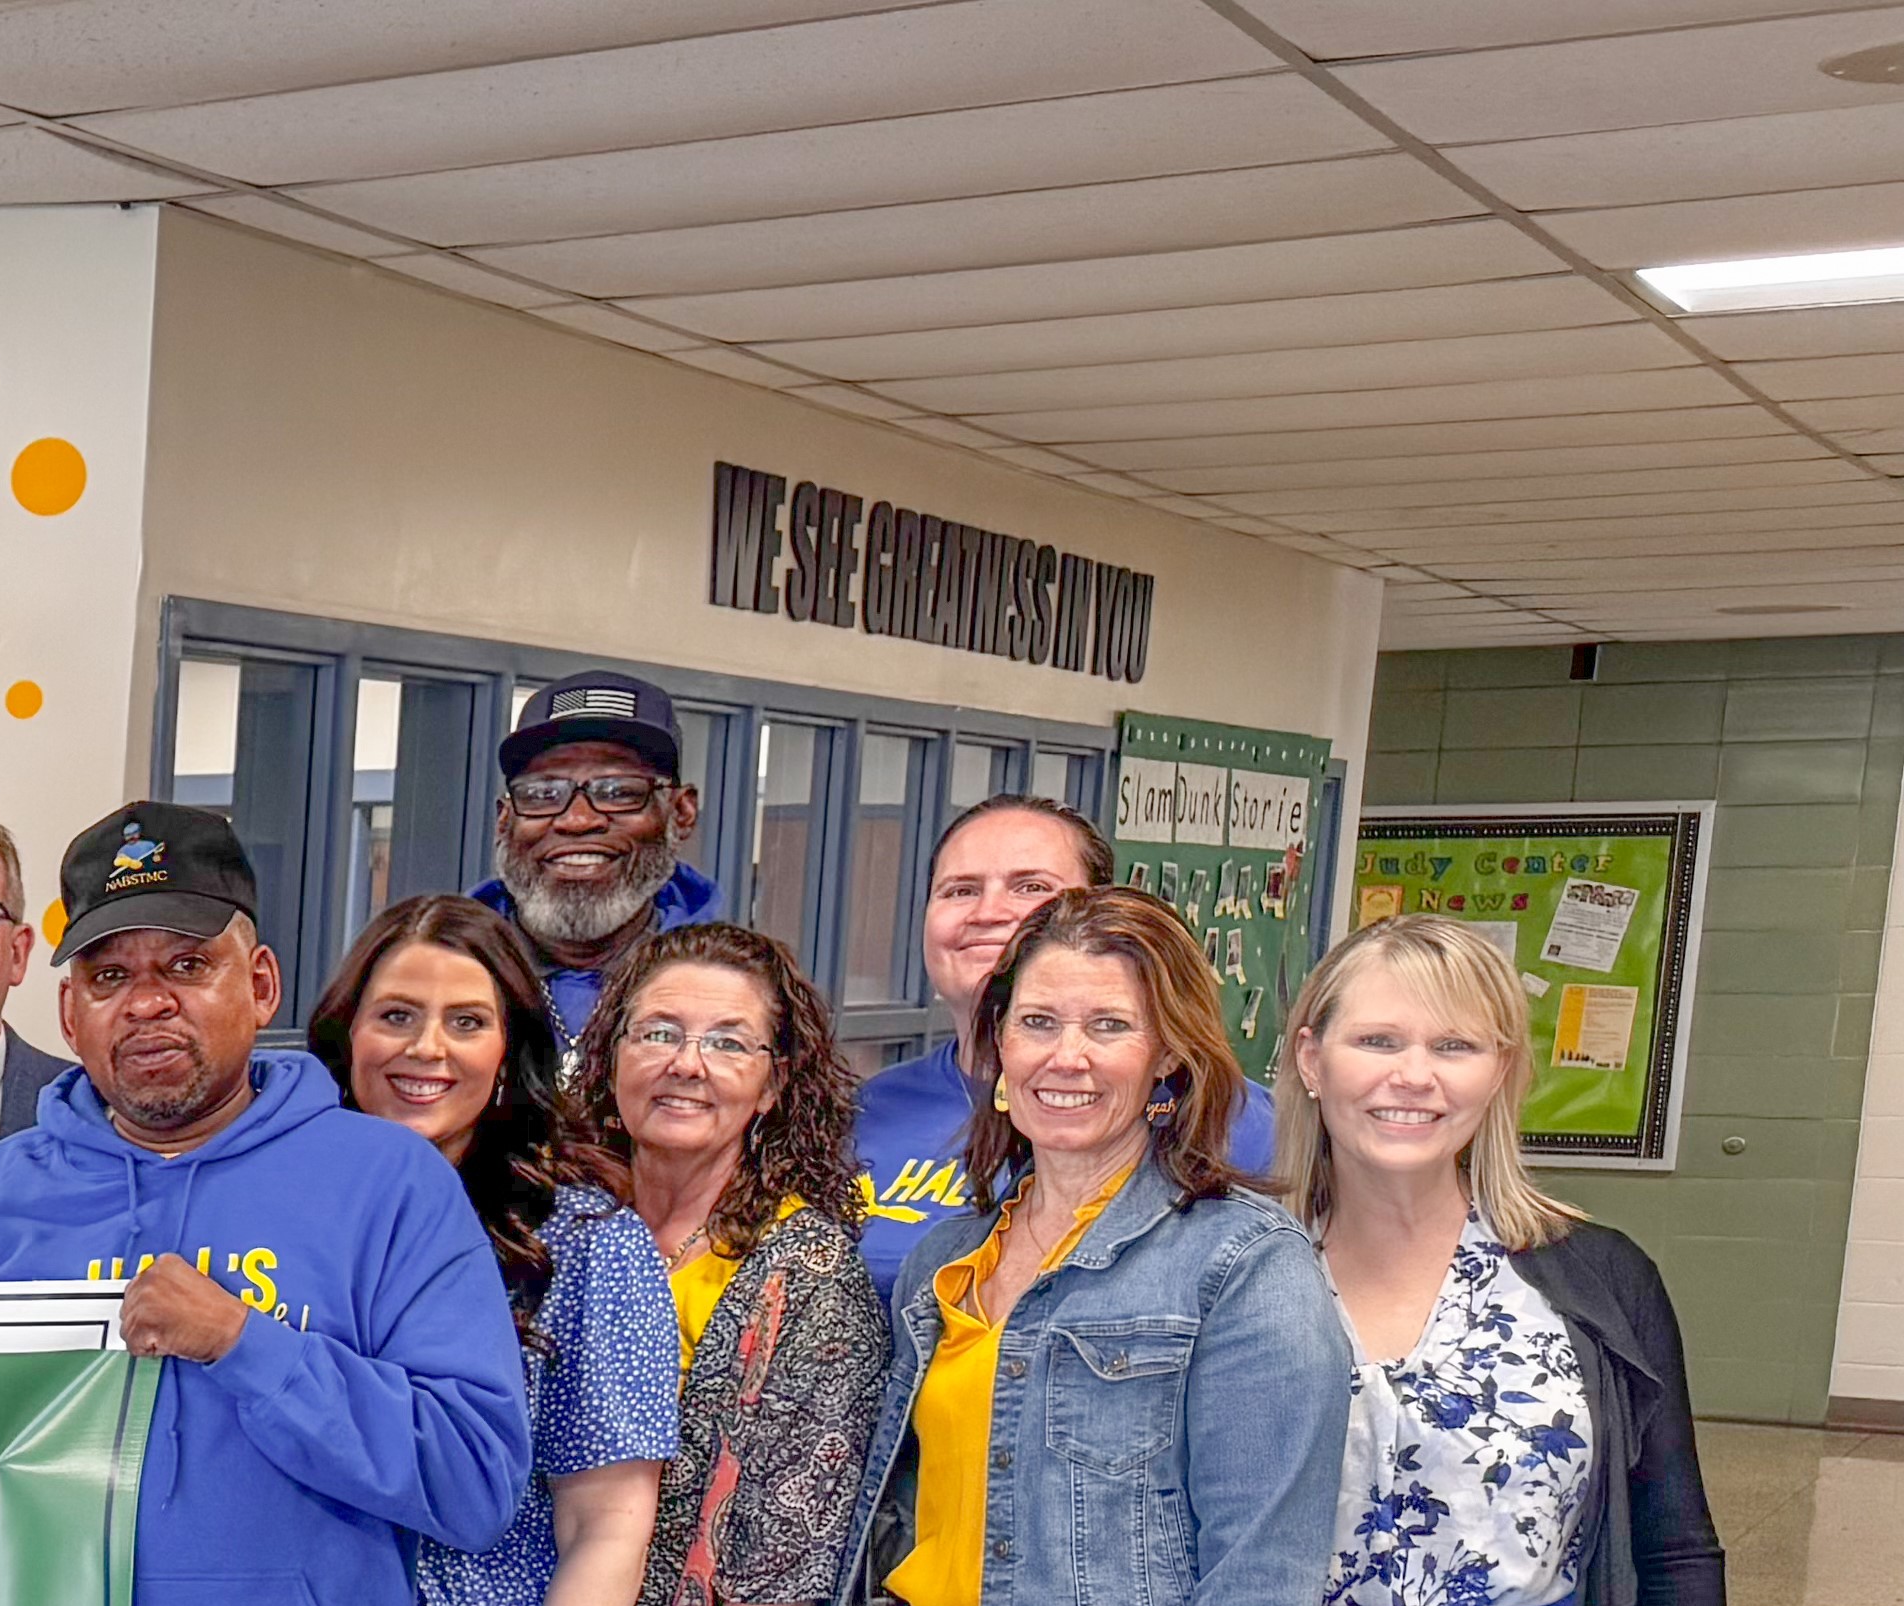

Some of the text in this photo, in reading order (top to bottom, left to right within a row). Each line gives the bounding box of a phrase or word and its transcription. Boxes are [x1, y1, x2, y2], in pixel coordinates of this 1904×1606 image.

[709, 460, 1155, 684] WE SEE GREATNESS IN YOU
[1118, 771, 1174, 828] Slam
[1176, 774, 1223, 828] Dunk
[1359, 851, 1614, 881] Judy Center
[1419, 887, 1530, 913] News
[879, 1158, 971, 1208] HAL
